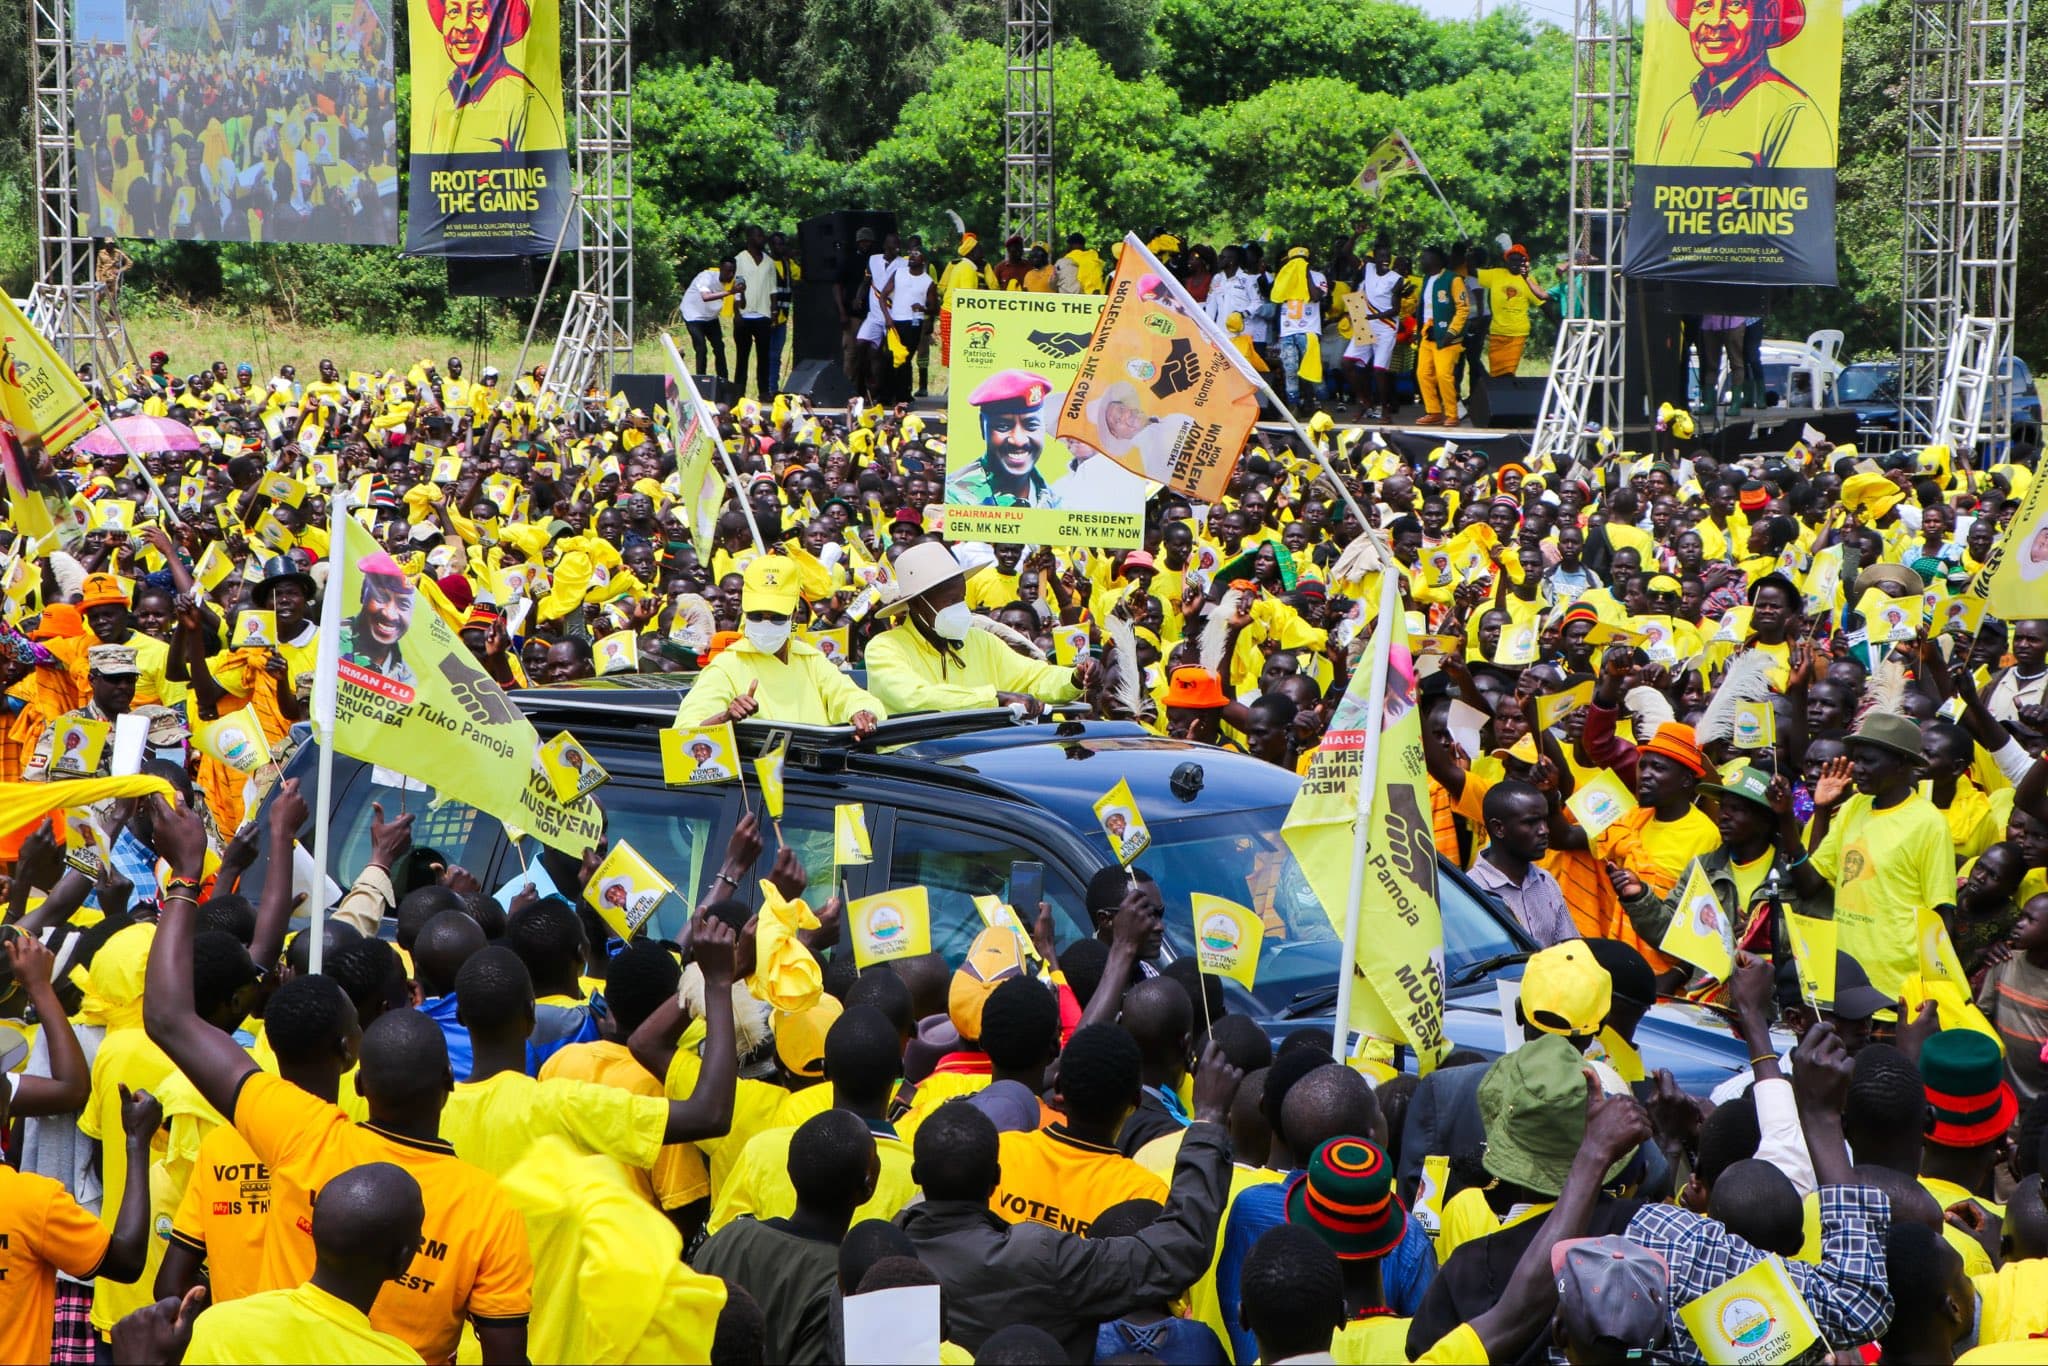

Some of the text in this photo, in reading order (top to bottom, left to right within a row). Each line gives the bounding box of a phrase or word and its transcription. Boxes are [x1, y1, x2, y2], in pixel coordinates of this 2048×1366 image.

[430, 168, 547, 192] PROTECTING
[438, 190, 540, 214] THE GAINS
[1654, 186, 1808, 210] PROTECTING
[1664, 211, 1794, 235] THE GAINS
[956, 297, 1056, 313] PROTECTING
[1062, 302, 1092, 314] THE
[963, 350, 996, 358] Patriotic
[1024, 360, 1046, 369] Tuko
[948, 509, 1024, 520] CHAIRMAN PLU
[1068, 514, 1134, 524] PRESIDENT
[951, 522, 1020, 534] GEN. MK NEXT
[1058, 526, 1140, 538] GEN. YK M7 NOW
[342, 681, 414, 717] MUHOOZI
[383, 682, 410, 698] PLU
[336, 706, 355, 724] EXT
[417, 702, 515, 758] Tuko Pamoja
[535, 819, 561, 838] NOW
[1369, 854, 1420, 927] Pamoja
[1408, 1012, 1434, 1051] NOW
[228, 1201, 242, 1215] IS
[248, 1200, 271, 1214] TH
[394, 1275, 434, 1294] EST
[1738, 1331, 1791, 1365] PROTECTING
[1766, 1342, 1792, 1362] GAINS
